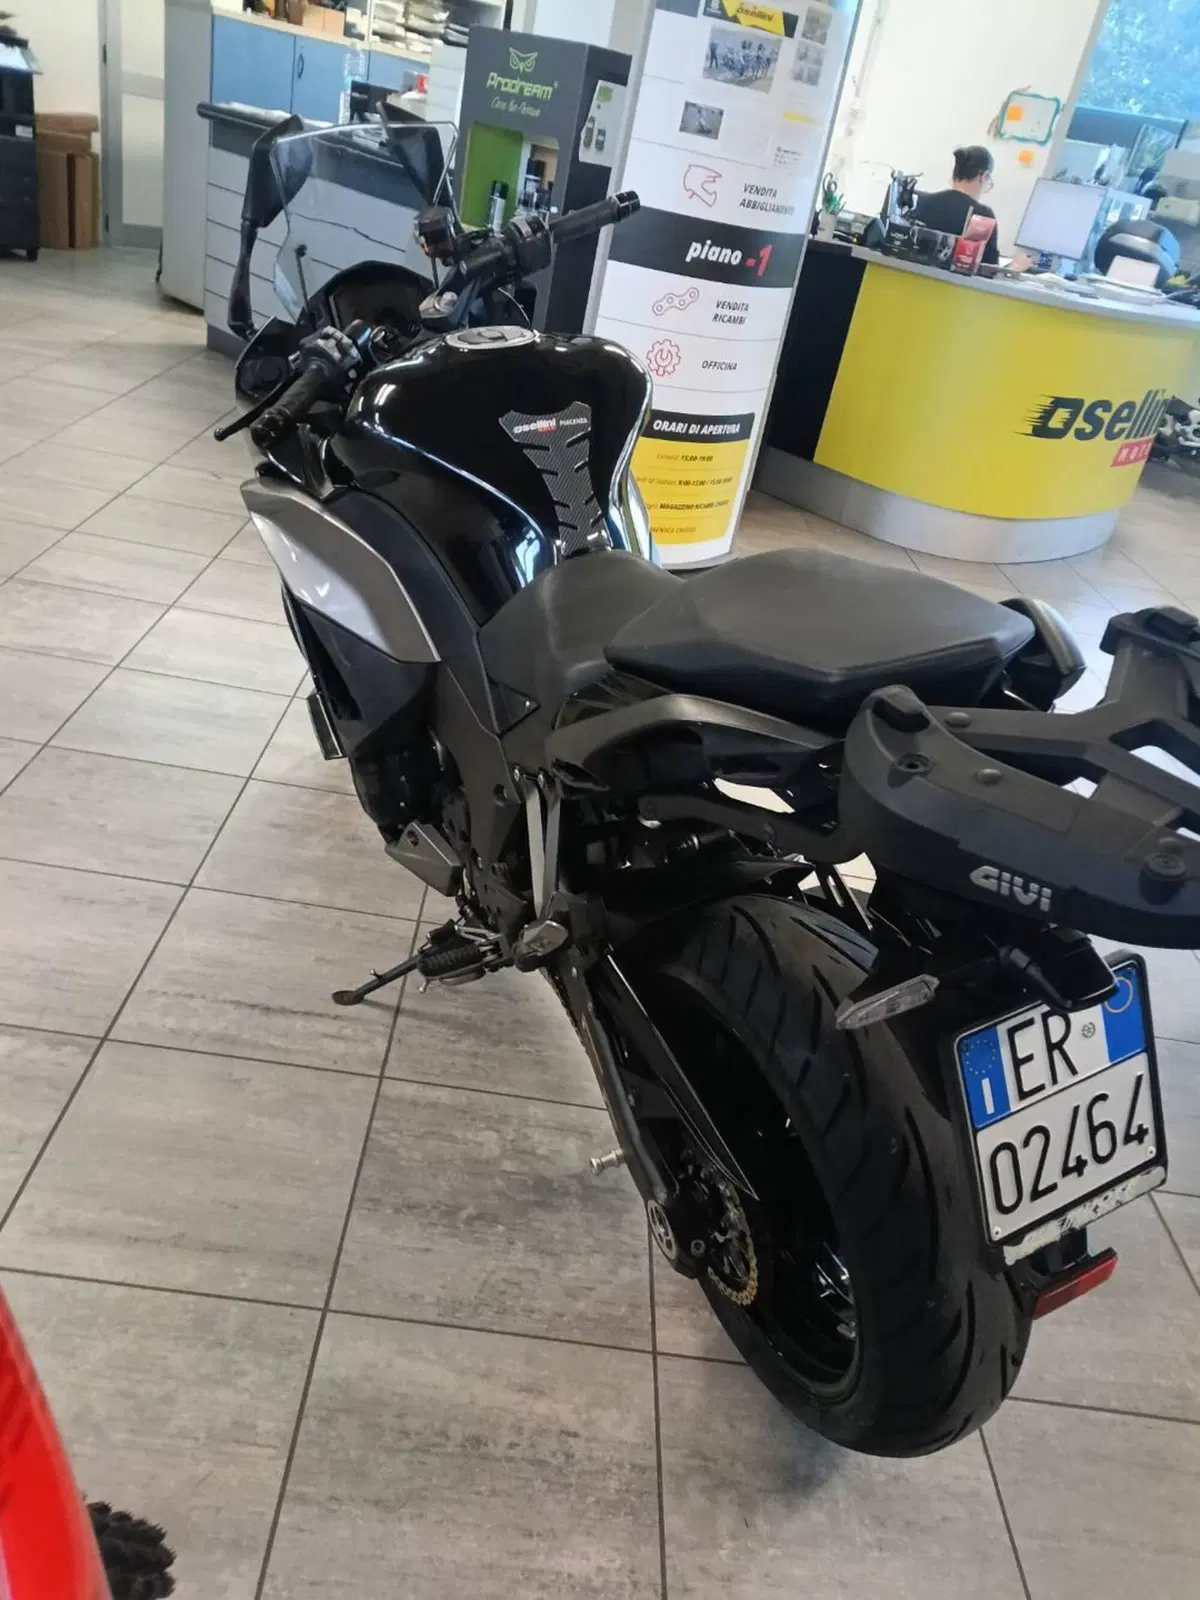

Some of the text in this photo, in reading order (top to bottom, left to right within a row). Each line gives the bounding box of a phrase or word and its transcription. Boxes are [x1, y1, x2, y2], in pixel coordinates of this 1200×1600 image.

[743, 182, 778, 199] VENDITA
[685, 239, 773, 277] piano -1
[715, 299, 750, 313] VENDITA
[712, 313, 747, 326] RICAMBI
[701, 360, 738, 372] OFFICINA
[652, 419, 741, 436] ORARI DI APERTURA
[968, 865, 1053, 913] GIVI
[1006, 1011, 1079, 1102] ER
[988, 1072, 1150, 1215] 02464
